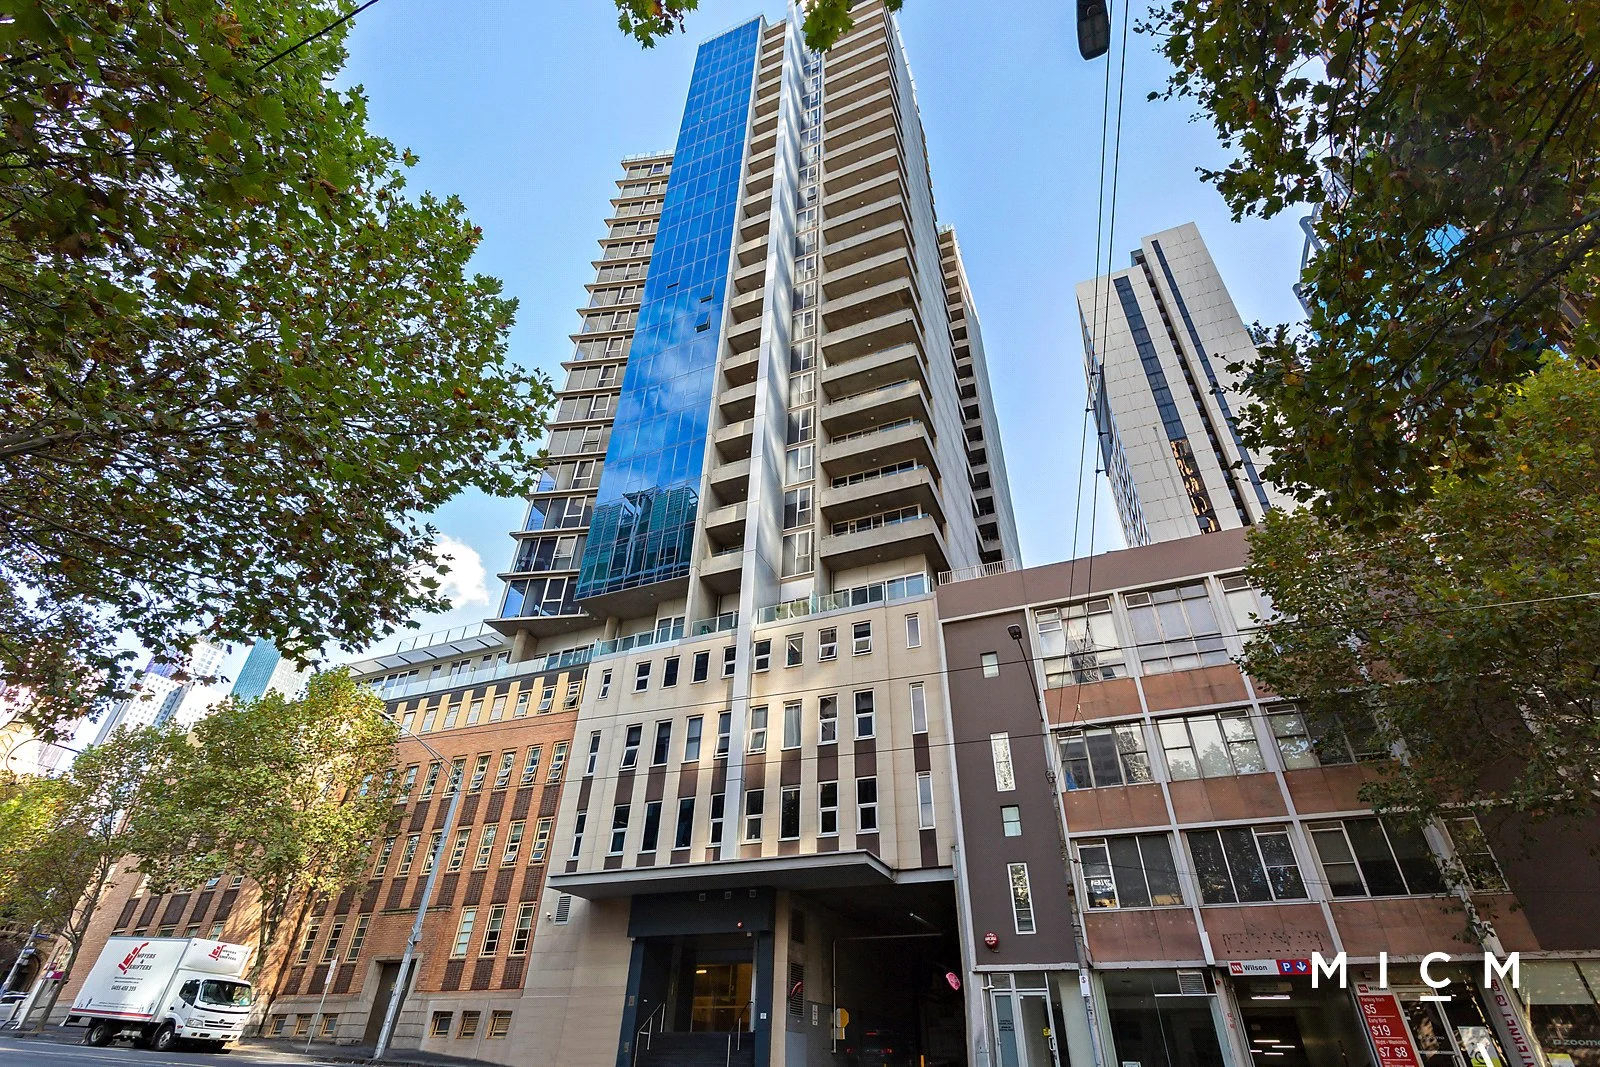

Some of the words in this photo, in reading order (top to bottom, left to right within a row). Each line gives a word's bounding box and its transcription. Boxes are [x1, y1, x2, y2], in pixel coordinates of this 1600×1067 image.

[1363, 1003, 1377, 1015] $5
[1371, 1024, 1391, 1036] $19
[1378, 1046, 1390, 1058] $7
[1394, 1046, 1408, 1058] $8
